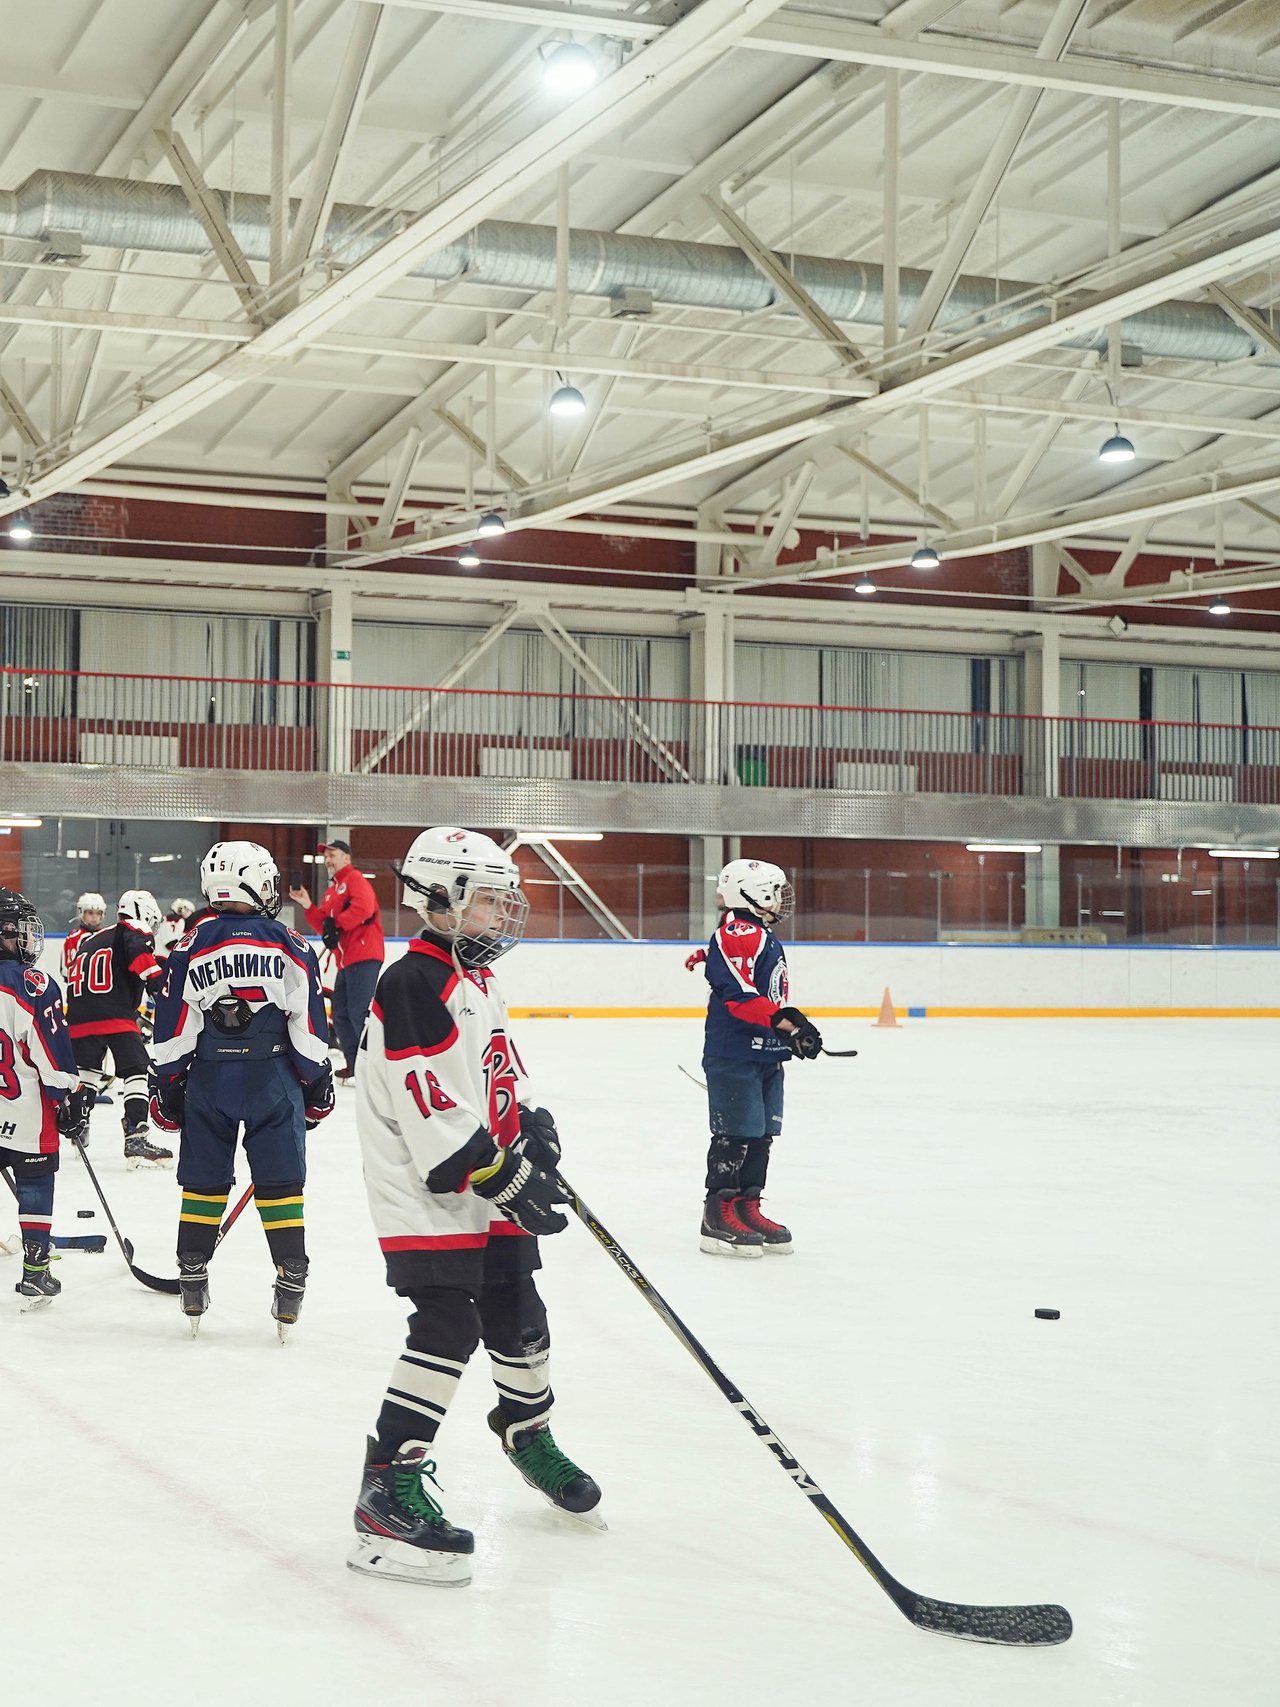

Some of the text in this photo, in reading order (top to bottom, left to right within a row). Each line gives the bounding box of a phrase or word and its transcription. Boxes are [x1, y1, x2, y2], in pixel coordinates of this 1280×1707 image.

[220, 860, 226, 871] 5
[419, 856, 452, 866] BAUER
[67, 946, 114, 998] 40
[405, 1069, 458, 1120] 16
[590, 1221, 611, 1245] SUPER
[607, 1244, 640, 1279] TACKS
[730, 1397, 824, 1497] CCM
